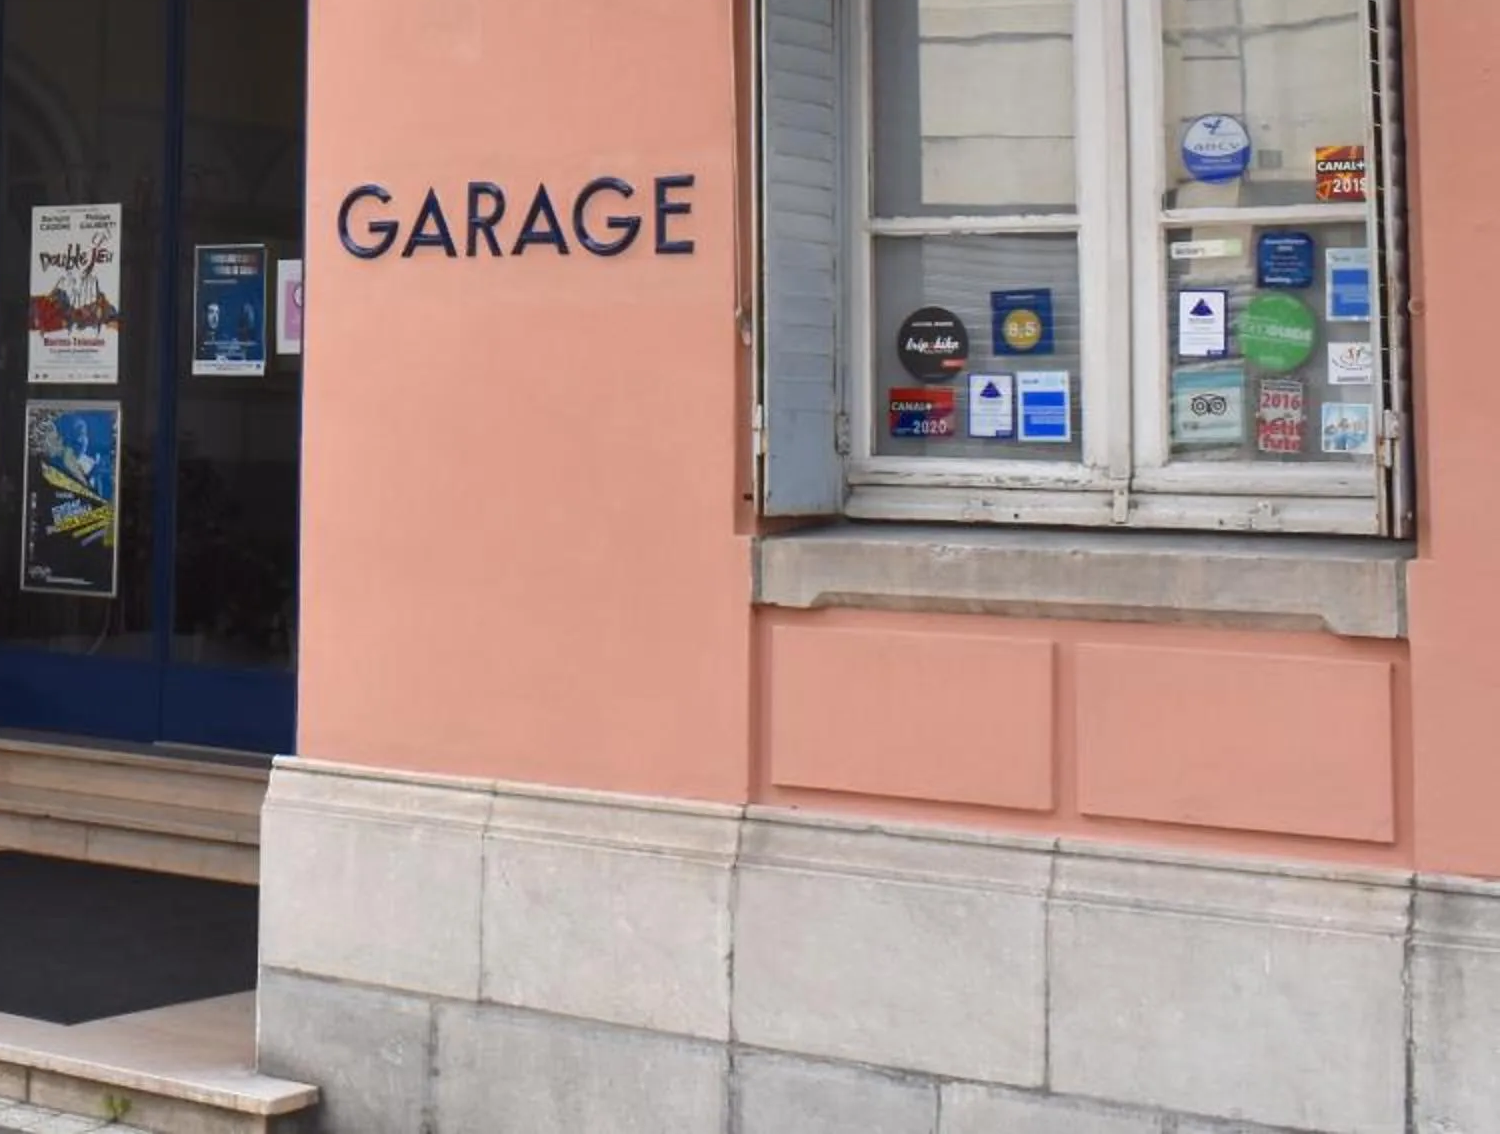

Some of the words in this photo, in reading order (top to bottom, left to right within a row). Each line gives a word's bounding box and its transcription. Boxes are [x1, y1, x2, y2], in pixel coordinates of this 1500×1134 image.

[1317, 159, 1366, 172] CANAL+
[337, 174, 695, 260] GARAGE
[1261, 392, 1301, 411] 2016
[912, 418, 948, 435] 2020
